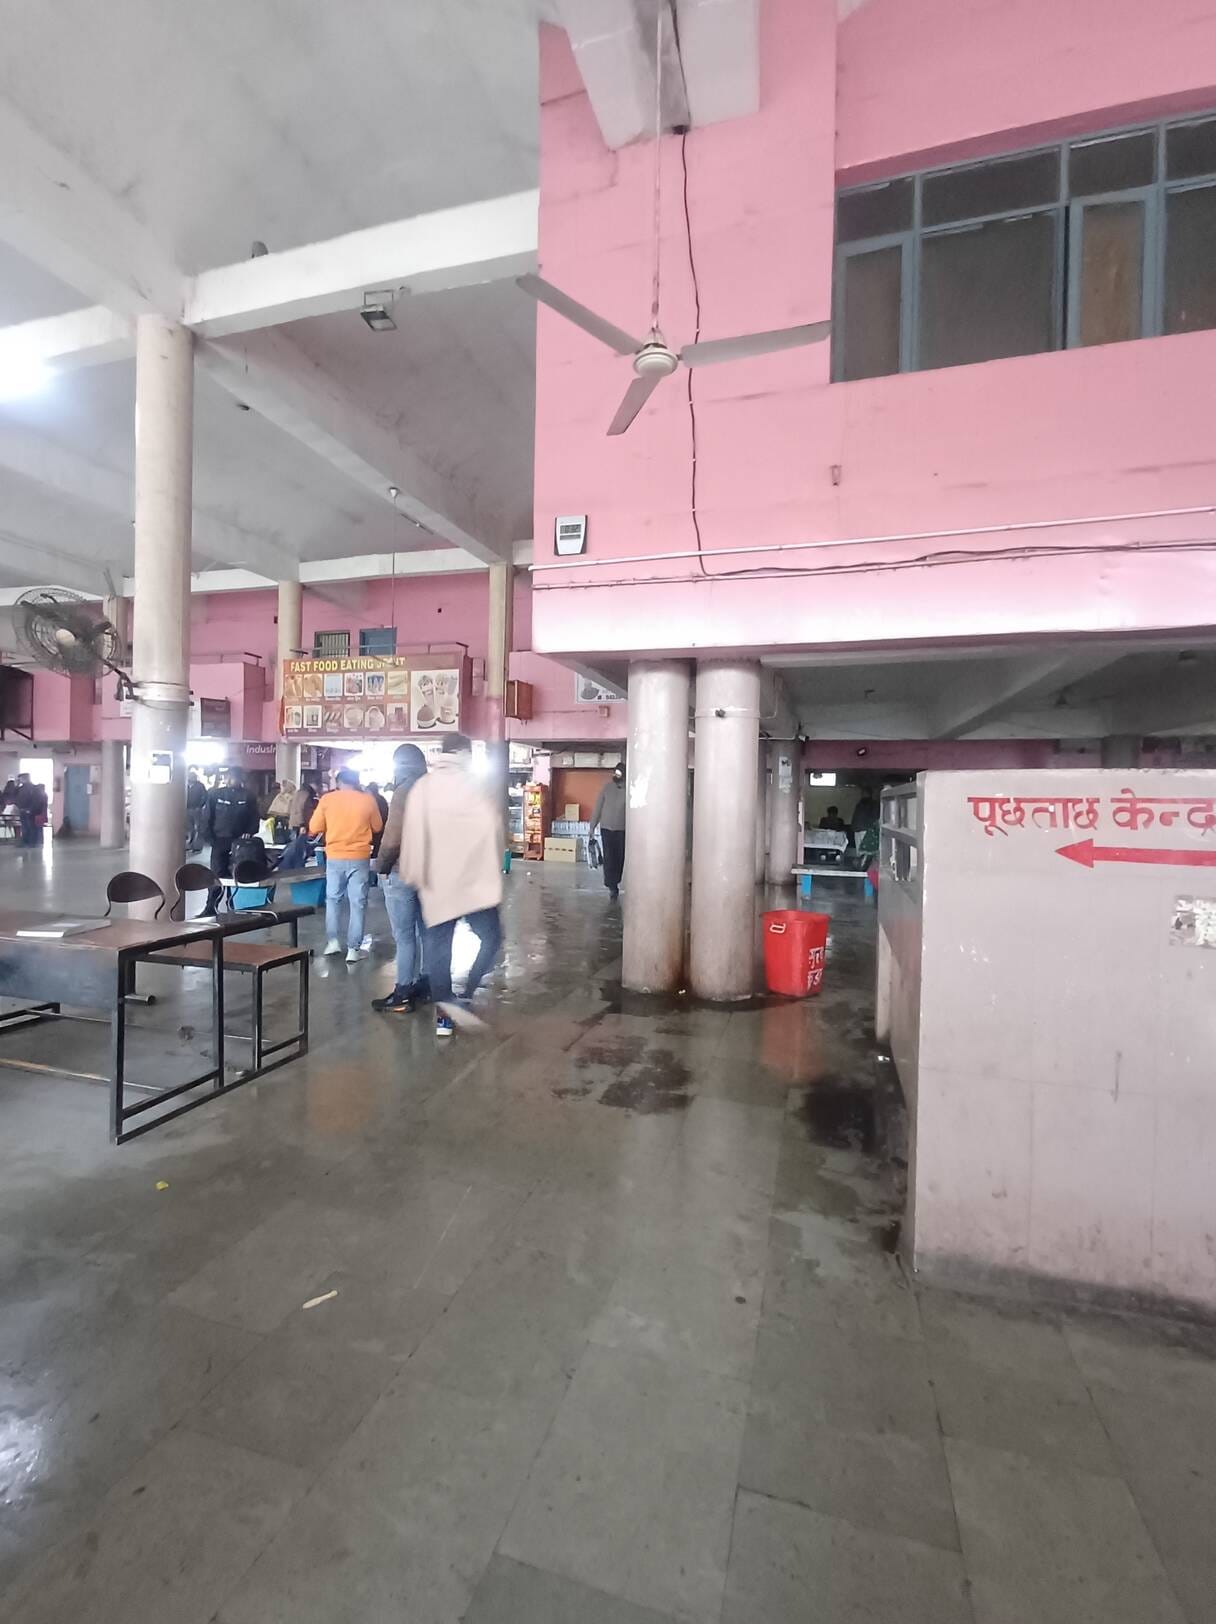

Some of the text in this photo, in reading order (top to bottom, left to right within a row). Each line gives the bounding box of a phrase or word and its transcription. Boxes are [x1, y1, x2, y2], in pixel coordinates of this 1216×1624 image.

[290, 661, 312, 673] FAST
[313, 660, 338, 672] FOOD
[340, 658, 374, 671] EATING
[967, 795, 1100, 837] पूछताछ
